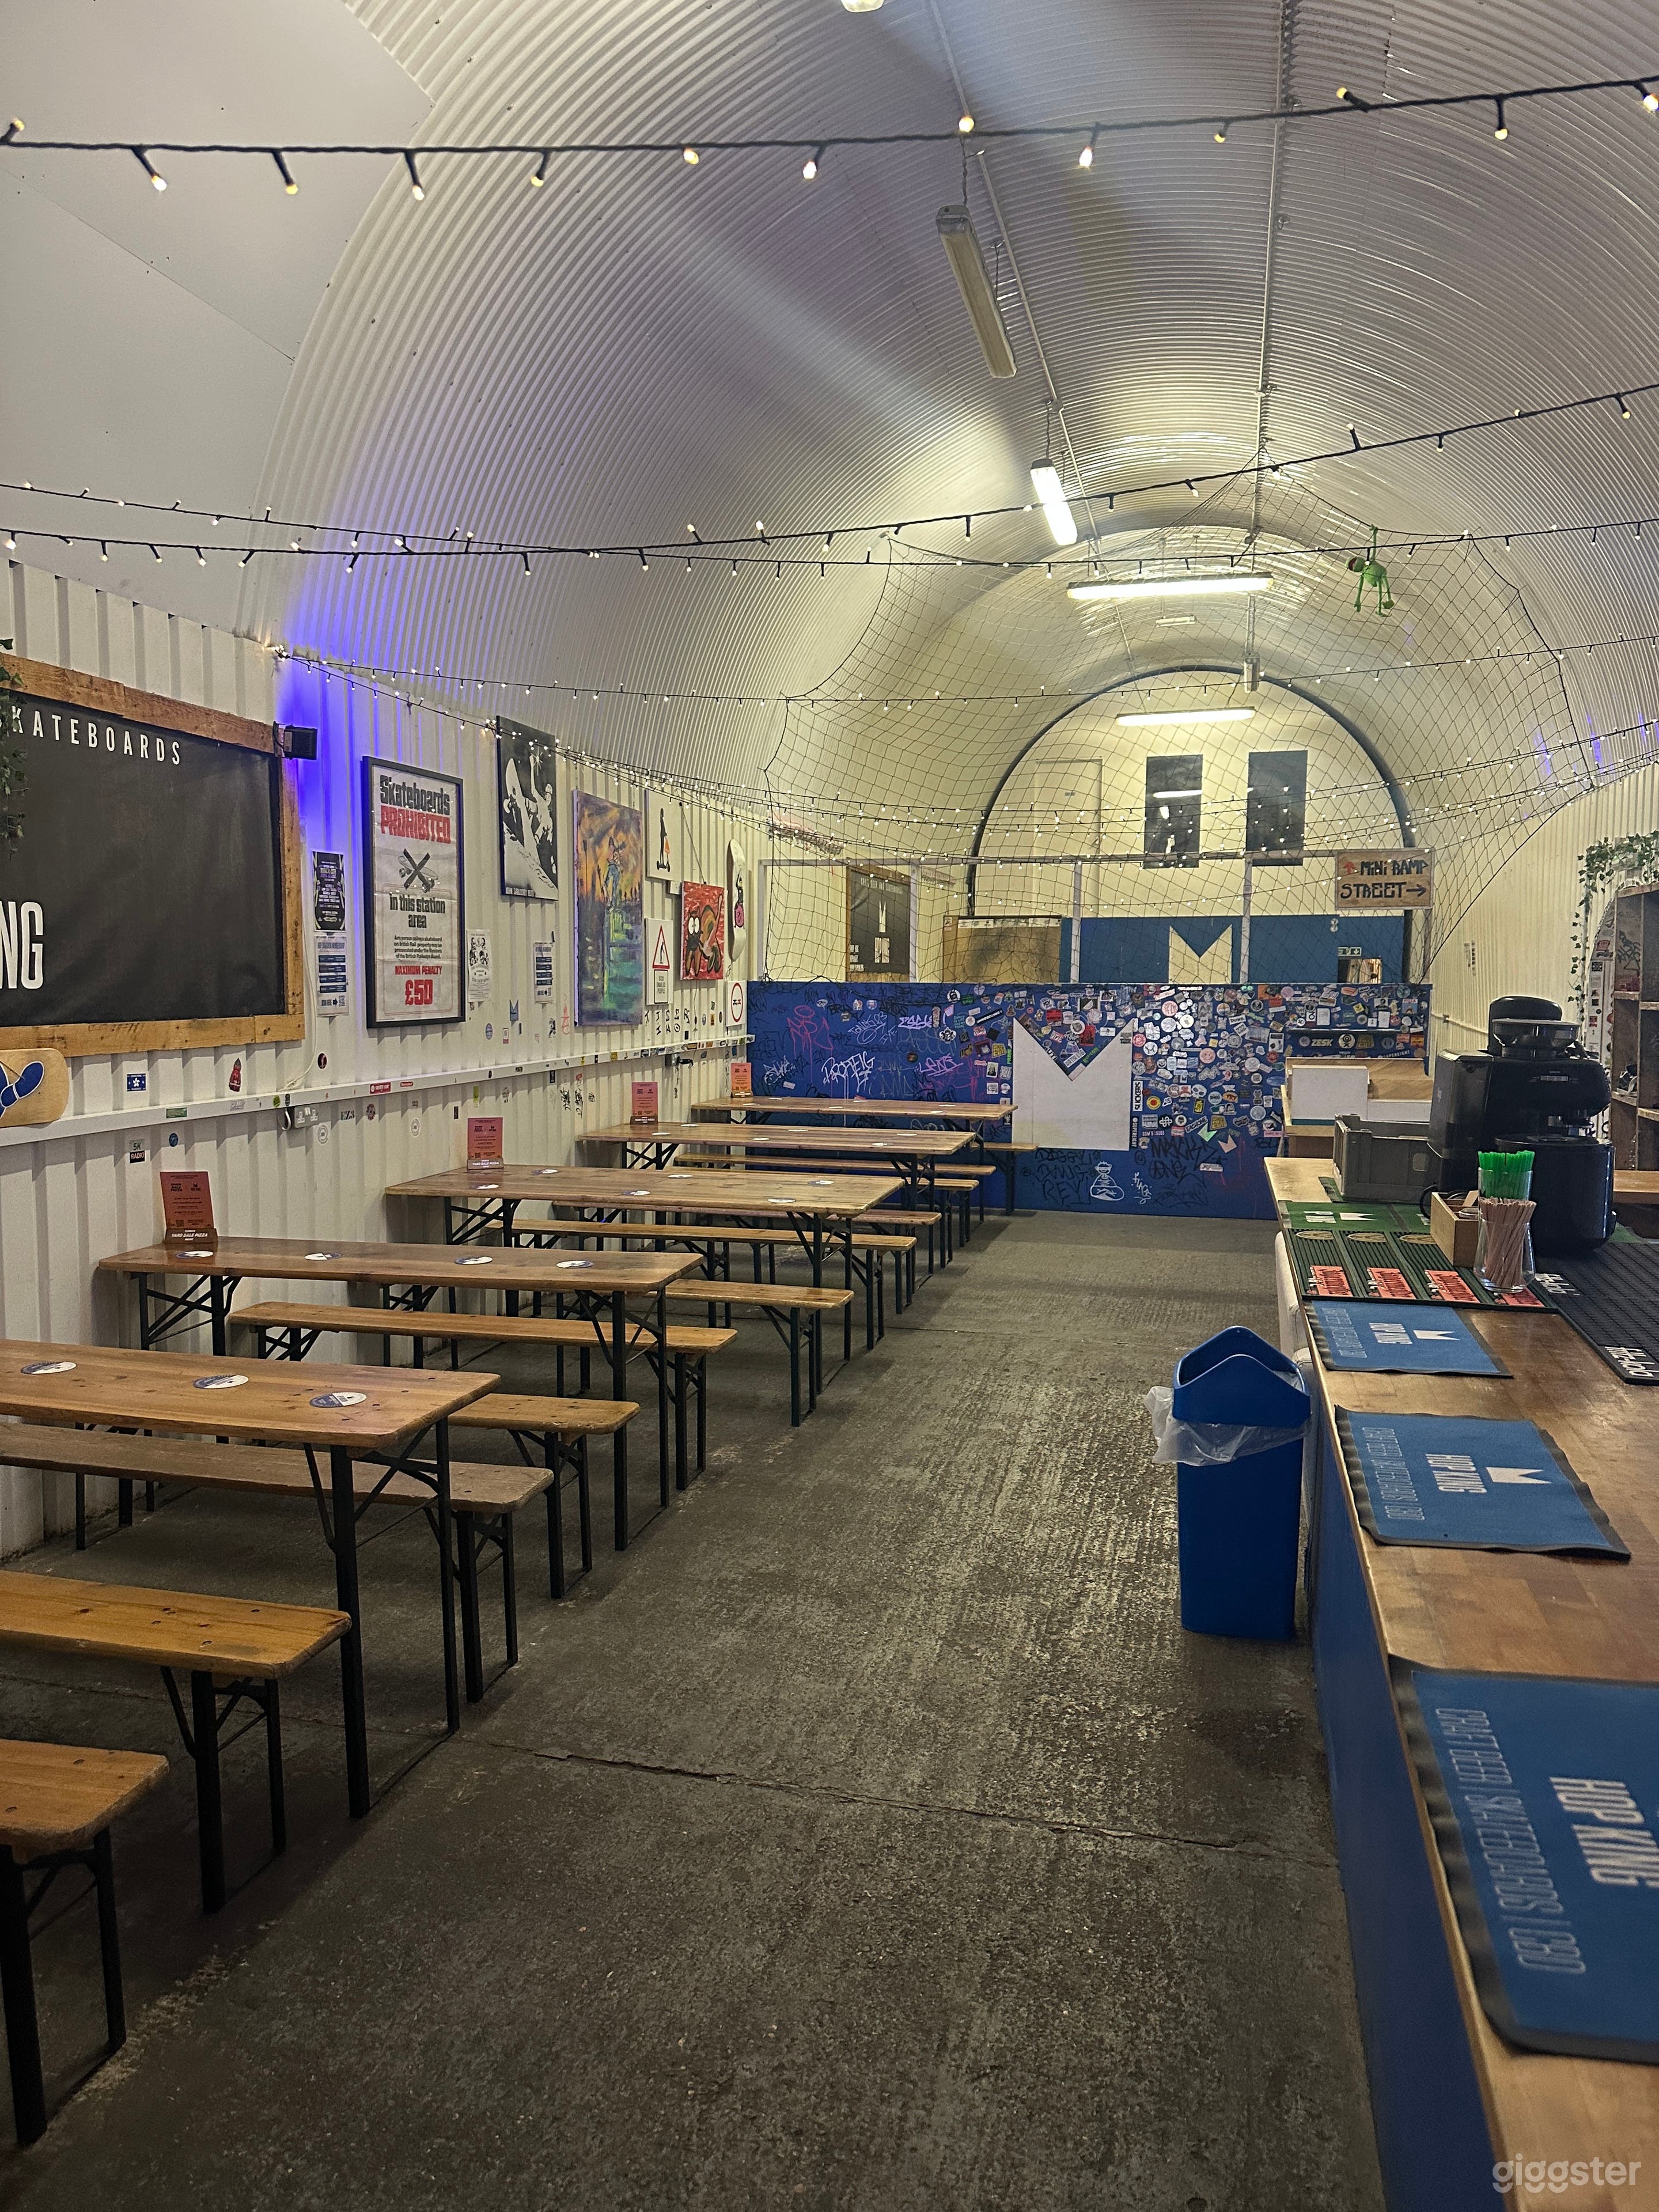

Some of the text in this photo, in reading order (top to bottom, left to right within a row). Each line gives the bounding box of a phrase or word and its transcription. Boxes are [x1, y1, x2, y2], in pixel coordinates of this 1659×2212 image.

[0, 706, 180, 765] KATEBOARDS
[380, 775, 450, 815] Skateboards
[381, 805, 451, 844] PROHIBITED
[1392, 859, 1429, 876] RAMP
[389, 893, 445, 914] in this station
[1340, 881, 1407, 899] STREET
[408, 914, 427, 928] area
[395, 965, 442, 975] MAXIMUM PENALTY
[405, 979, 433, 1005] £50
[1369, 1323, 1413, 1344] HOP KING
[1605, 1346, 1659, 1377] fritz-kola
[1426, 1453, 1487, 1493] HOP KING
[1435, 1708, 1586, 1975] CRAFT BEER SKATEBOARDS CBD
[1549, 1776, 1659, 1889] HOP KING
